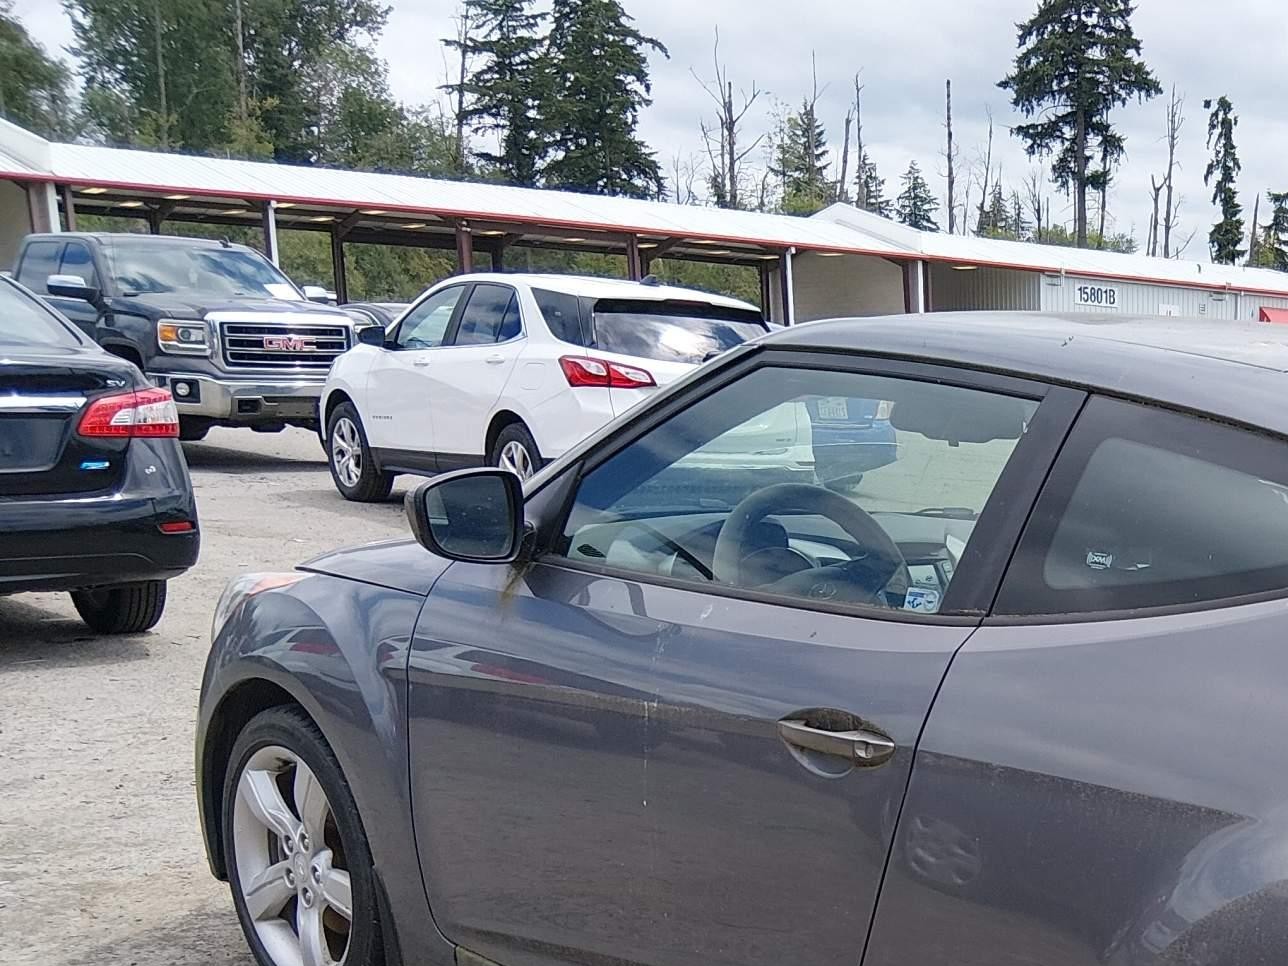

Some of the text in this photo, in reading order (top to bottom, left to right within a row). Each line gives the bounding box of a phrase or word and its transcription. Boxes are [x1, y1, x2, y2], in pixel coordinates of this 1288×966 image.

[1077, 286, 1116, 305] 15801B
[263, 335, 317, 351] GMC
[106, 379, 126, 387] SV
